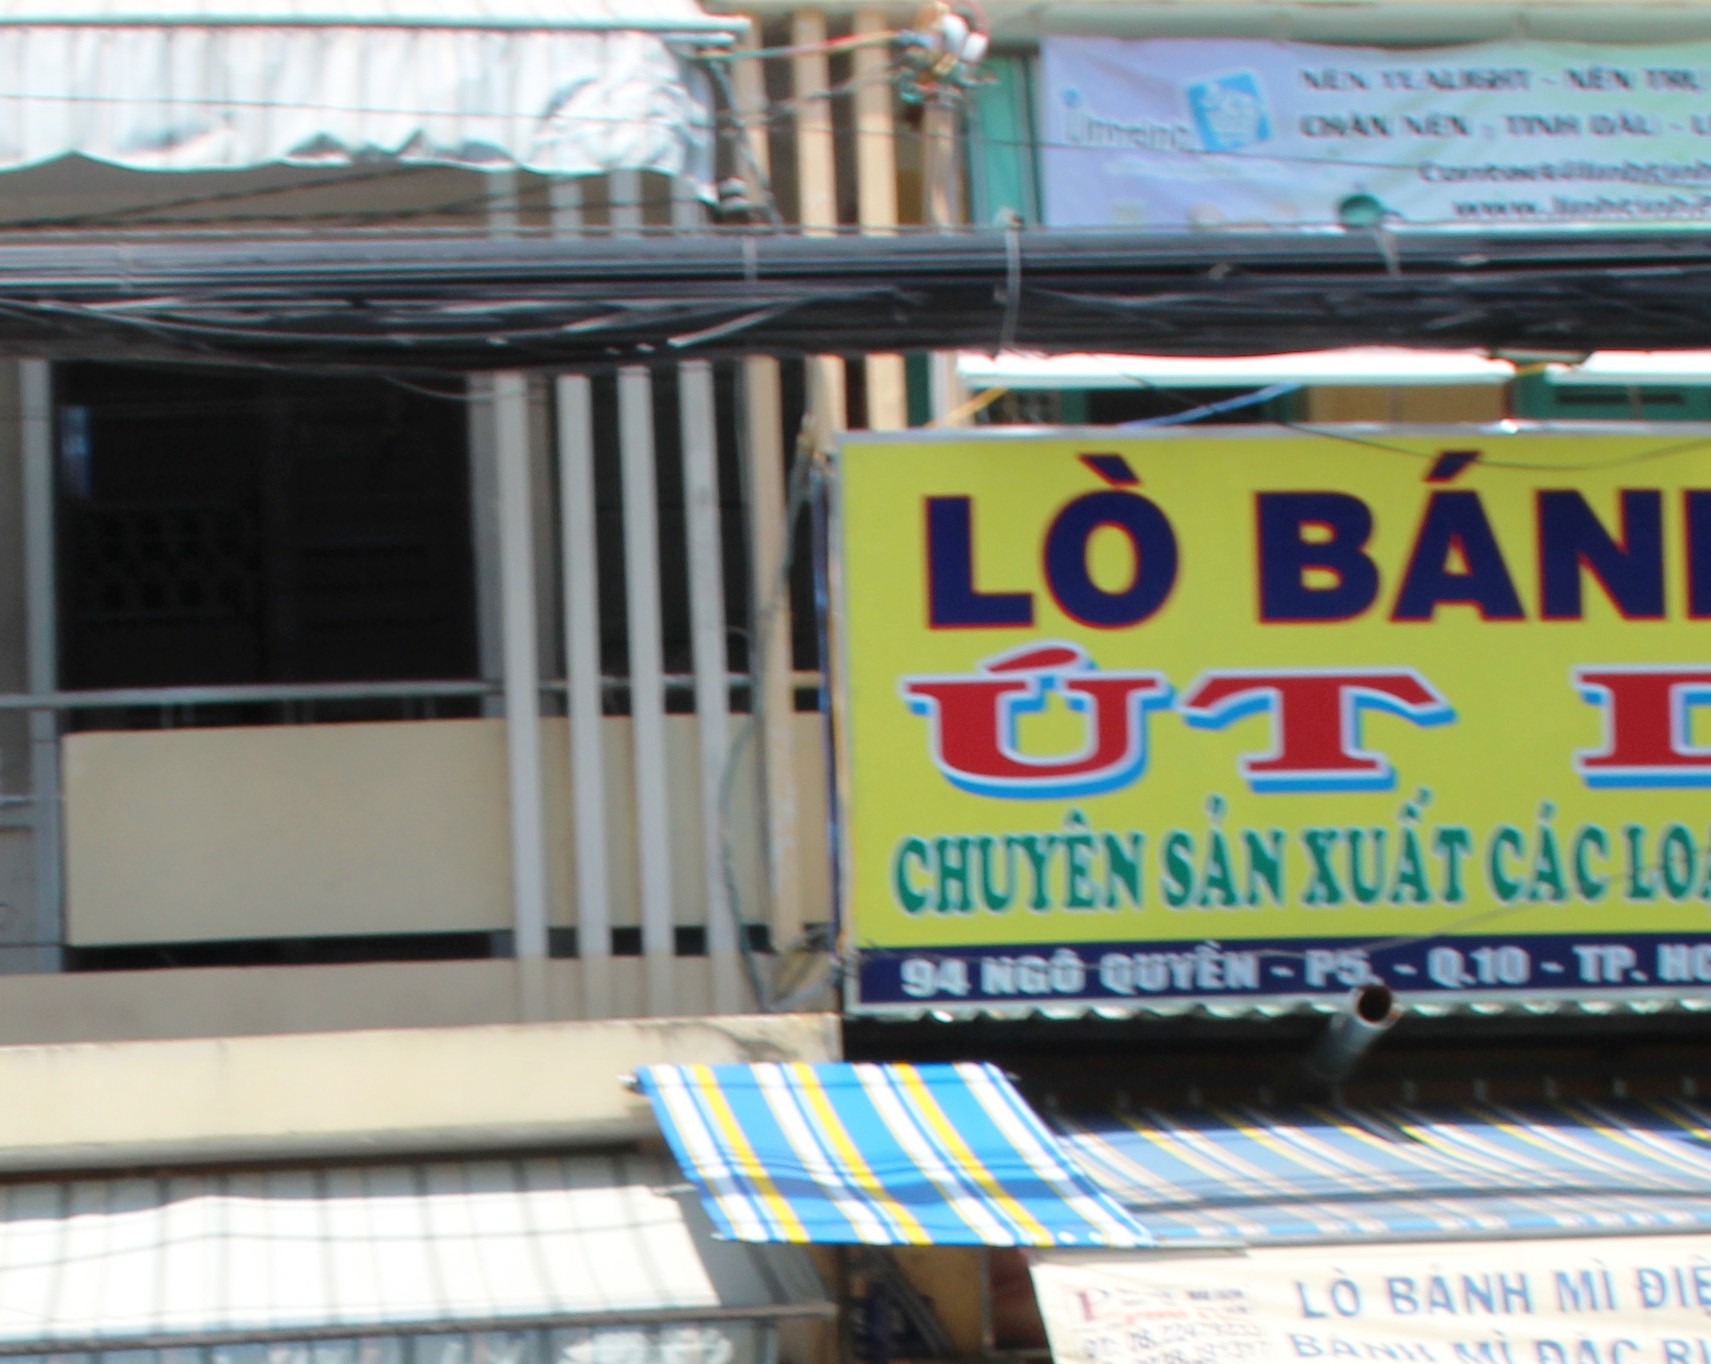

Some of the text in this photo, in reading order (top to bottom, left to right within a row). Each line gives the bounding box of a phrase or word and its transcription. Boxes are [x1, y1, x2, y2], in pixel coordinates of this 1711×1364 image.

[922, 449, 1711, 630] LÒ BÁN
[895, 806, 1146, 916] CHUYÊN
[1160, 792, 1286, 909] SẢN
[1301, 786, 1474, 908] XUẤT
[1624, 820, 1711, 905] LO
[900, 957, 971, 998] 94
[981, 946, 1087, 996] NGÔ
[1099, 939, 1261, 996] QUYỀN
[1293, 1267, 1363, 1319] LÒ
